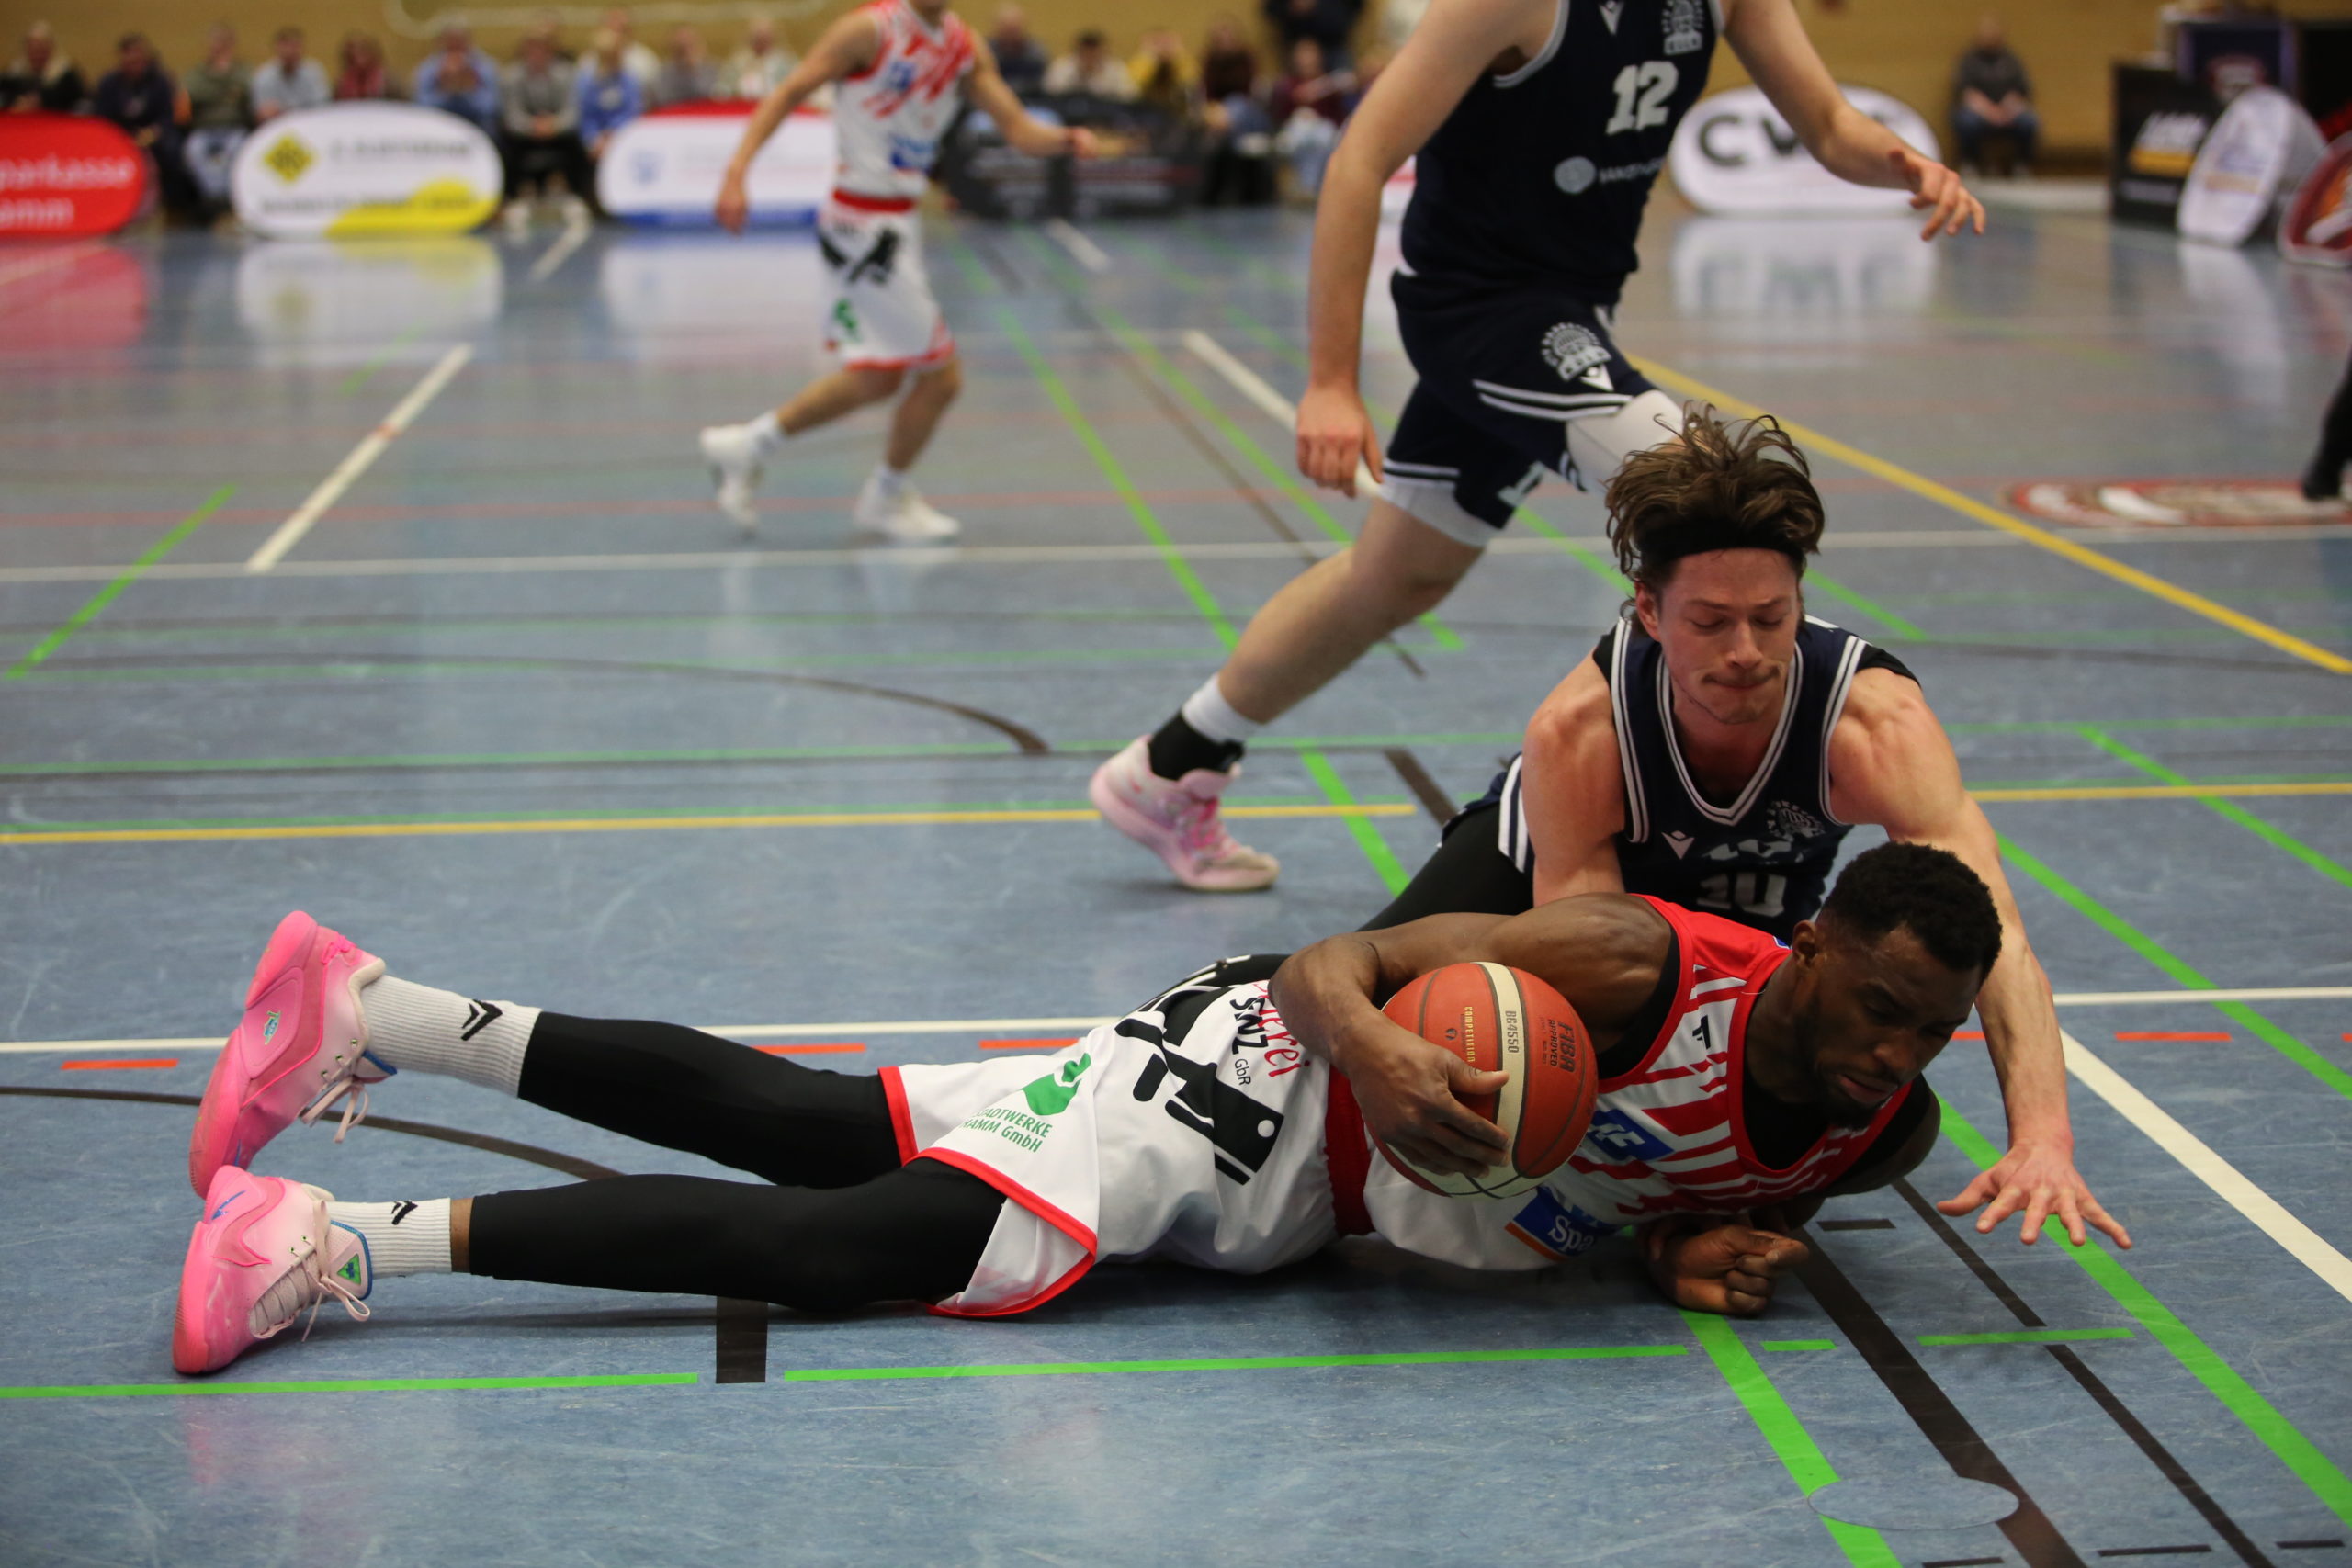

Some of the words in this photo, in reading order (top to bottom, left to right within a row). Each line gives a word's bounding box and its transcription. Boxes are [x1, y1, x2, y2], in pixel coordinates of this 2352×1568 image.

[1605, 60, 1679, 136] 12
[0, 152, 136, 191] parkasse
[0, 197, 74, 229] amm
[1464, 1006, 1476, 1062] COMPETITION
[1504, 1010, 1520, 1054] BG4550
[1548, 1020, 1558, 1066] APPROVED
[1558, 1021, 1577, 1073] FIBA
[1234, 1058, 1252, 1086] GbR
[1001, 1125, 1043, 1154] GmbH
